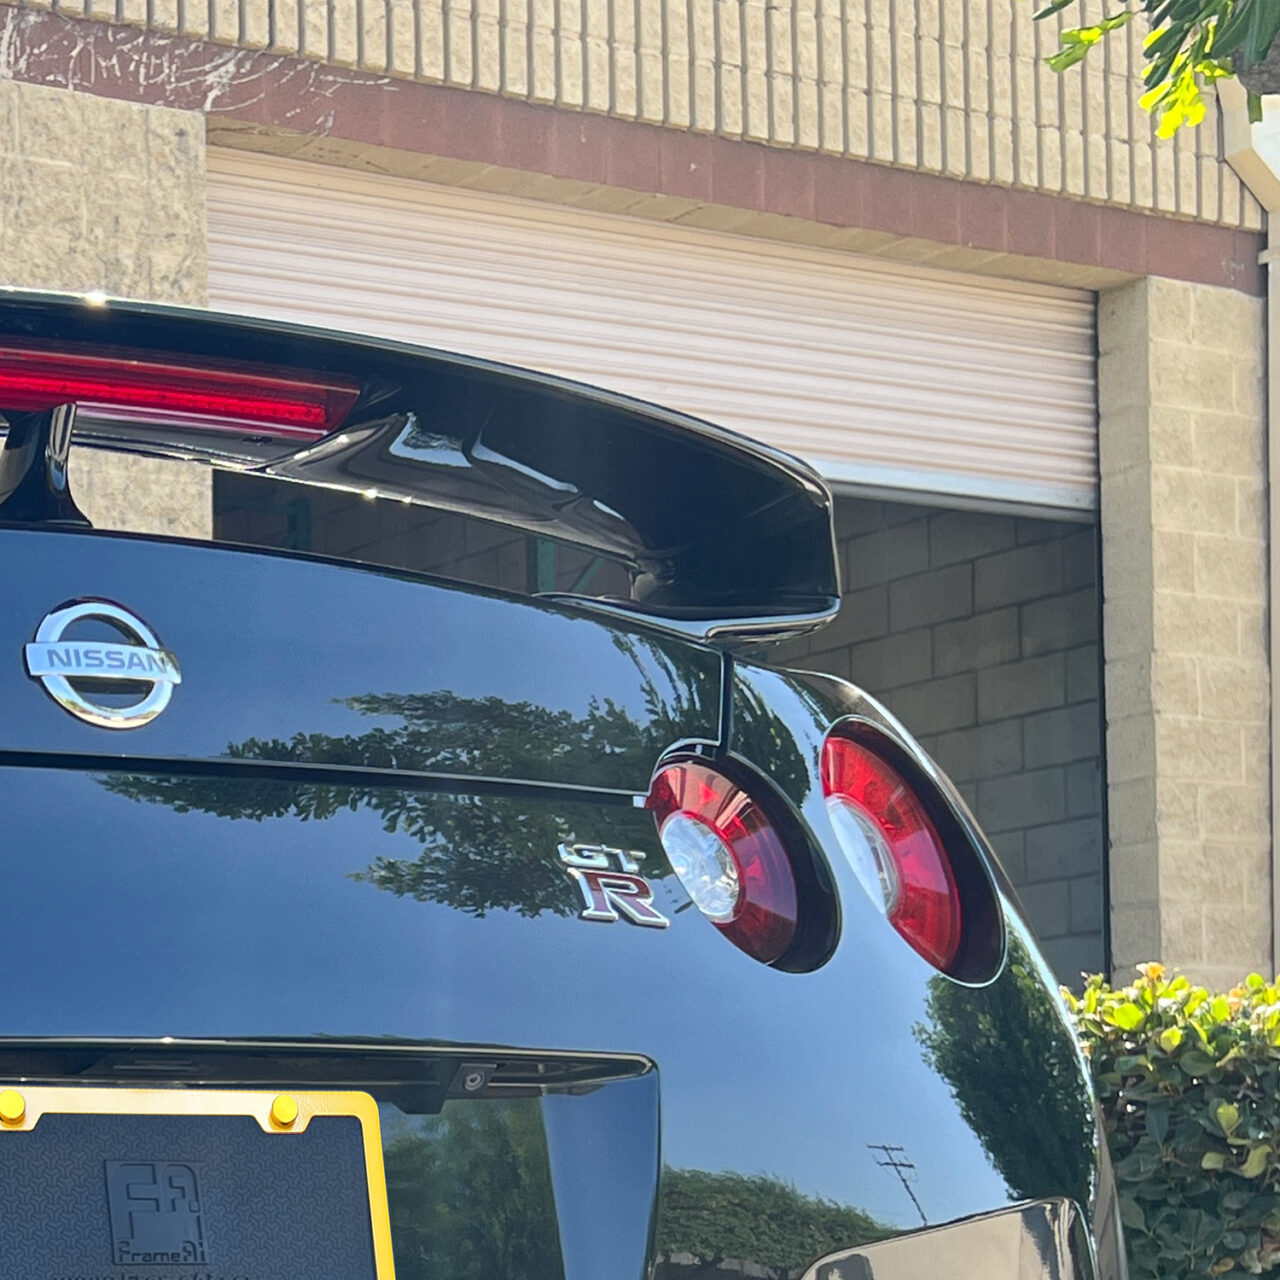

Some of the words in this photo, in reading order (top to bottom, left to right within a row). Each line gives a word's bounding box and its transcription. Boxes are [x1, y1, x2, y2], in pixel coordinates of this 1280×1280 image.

[47, 648, 170, 674] NISSAN
[557, 843, 647, 874] GT
[566, 867, 671, 928] R
